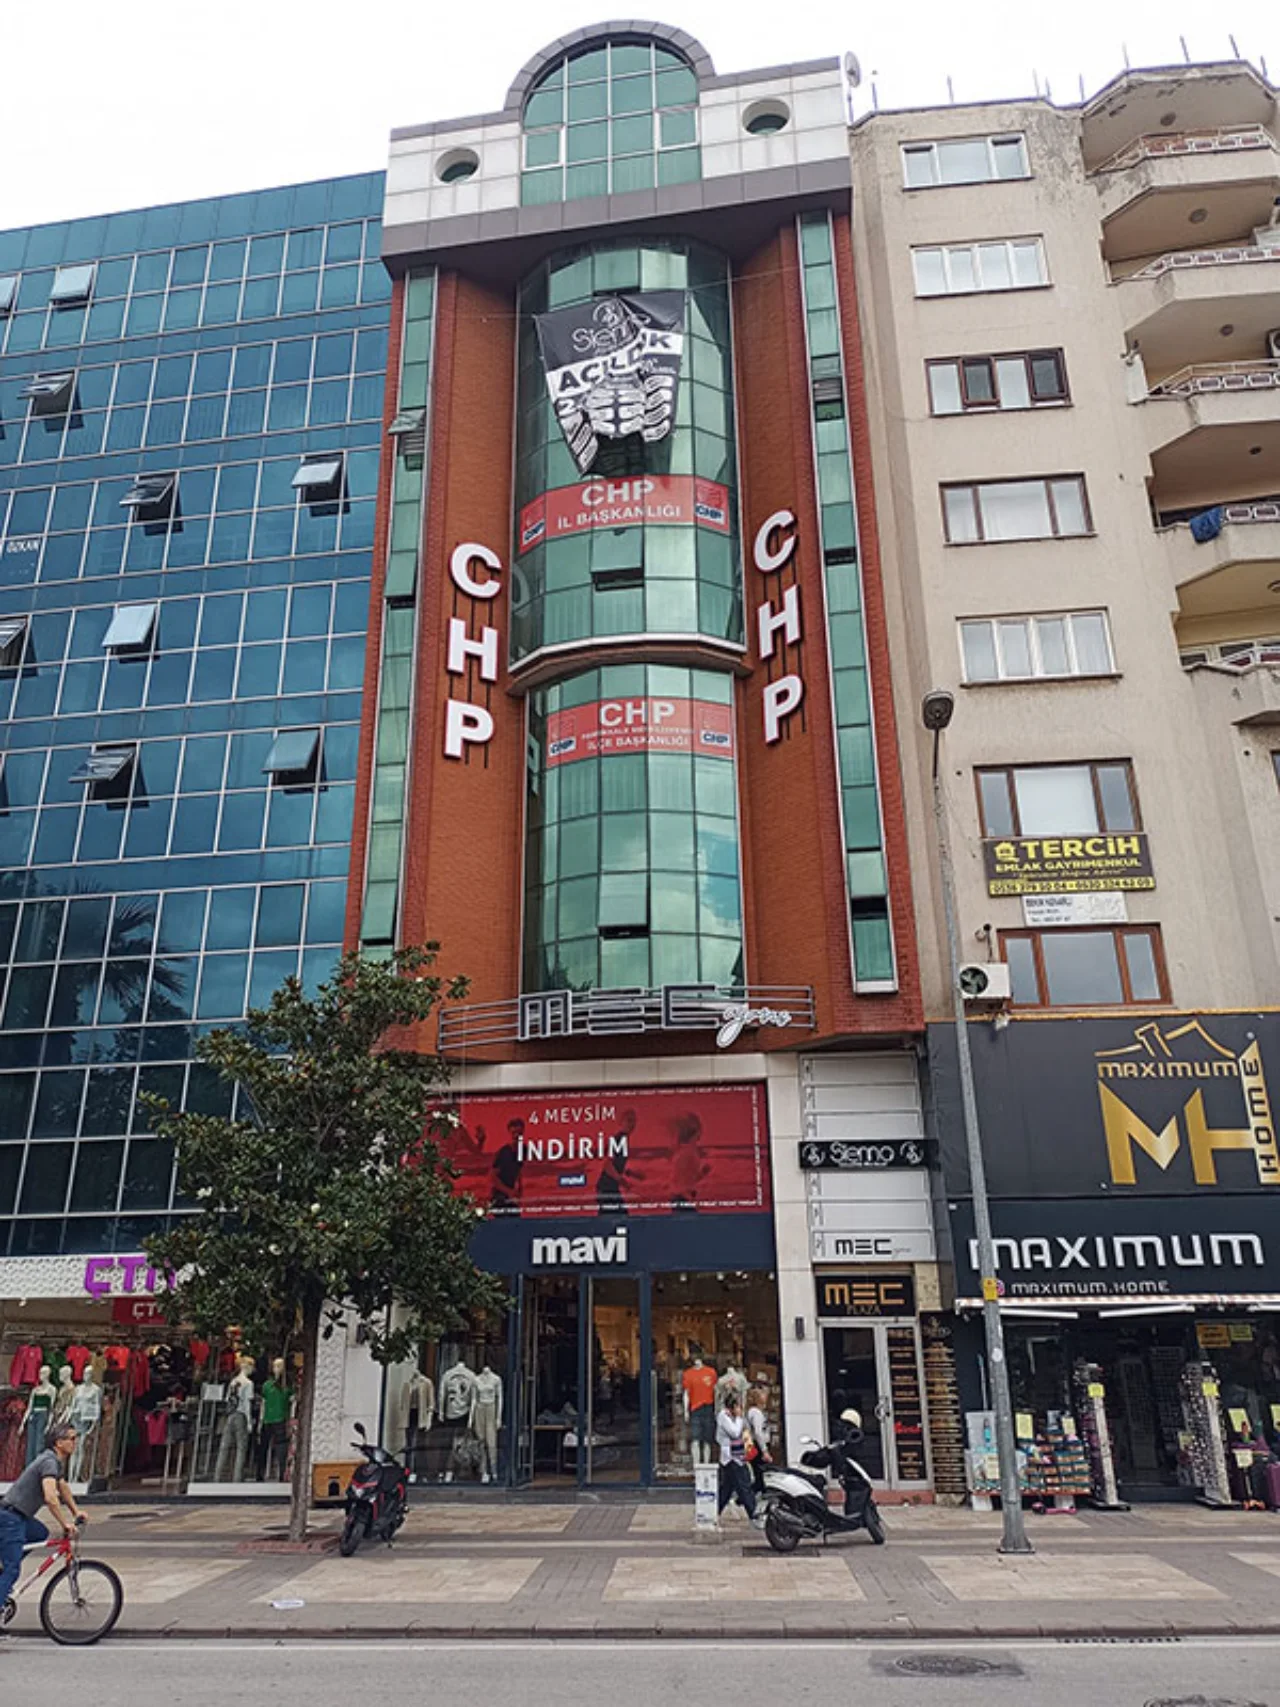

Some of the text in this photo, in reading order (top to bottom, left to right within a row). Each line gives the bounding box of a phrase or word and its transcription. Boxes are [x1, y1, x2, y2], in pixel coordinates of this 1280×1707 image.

[582, 478, 655, 506] CHP
[576, 504, 682, 526] BAŞKANLIĞI
[600, 700, 676, 726] CHP
[995, 861, 1042, 873] EMLAK
[529, 1106, 616, 1125] 4 MEVSİM
[1242, 1055, 1280, 1175] HOME
[517, 1132, 629, 1161] İNDİRİM
[532, 1227, 627, 1264] mavi
[835, 1238, 892, 1255] MEC
[824, 1283, 905, 1305] MEC
